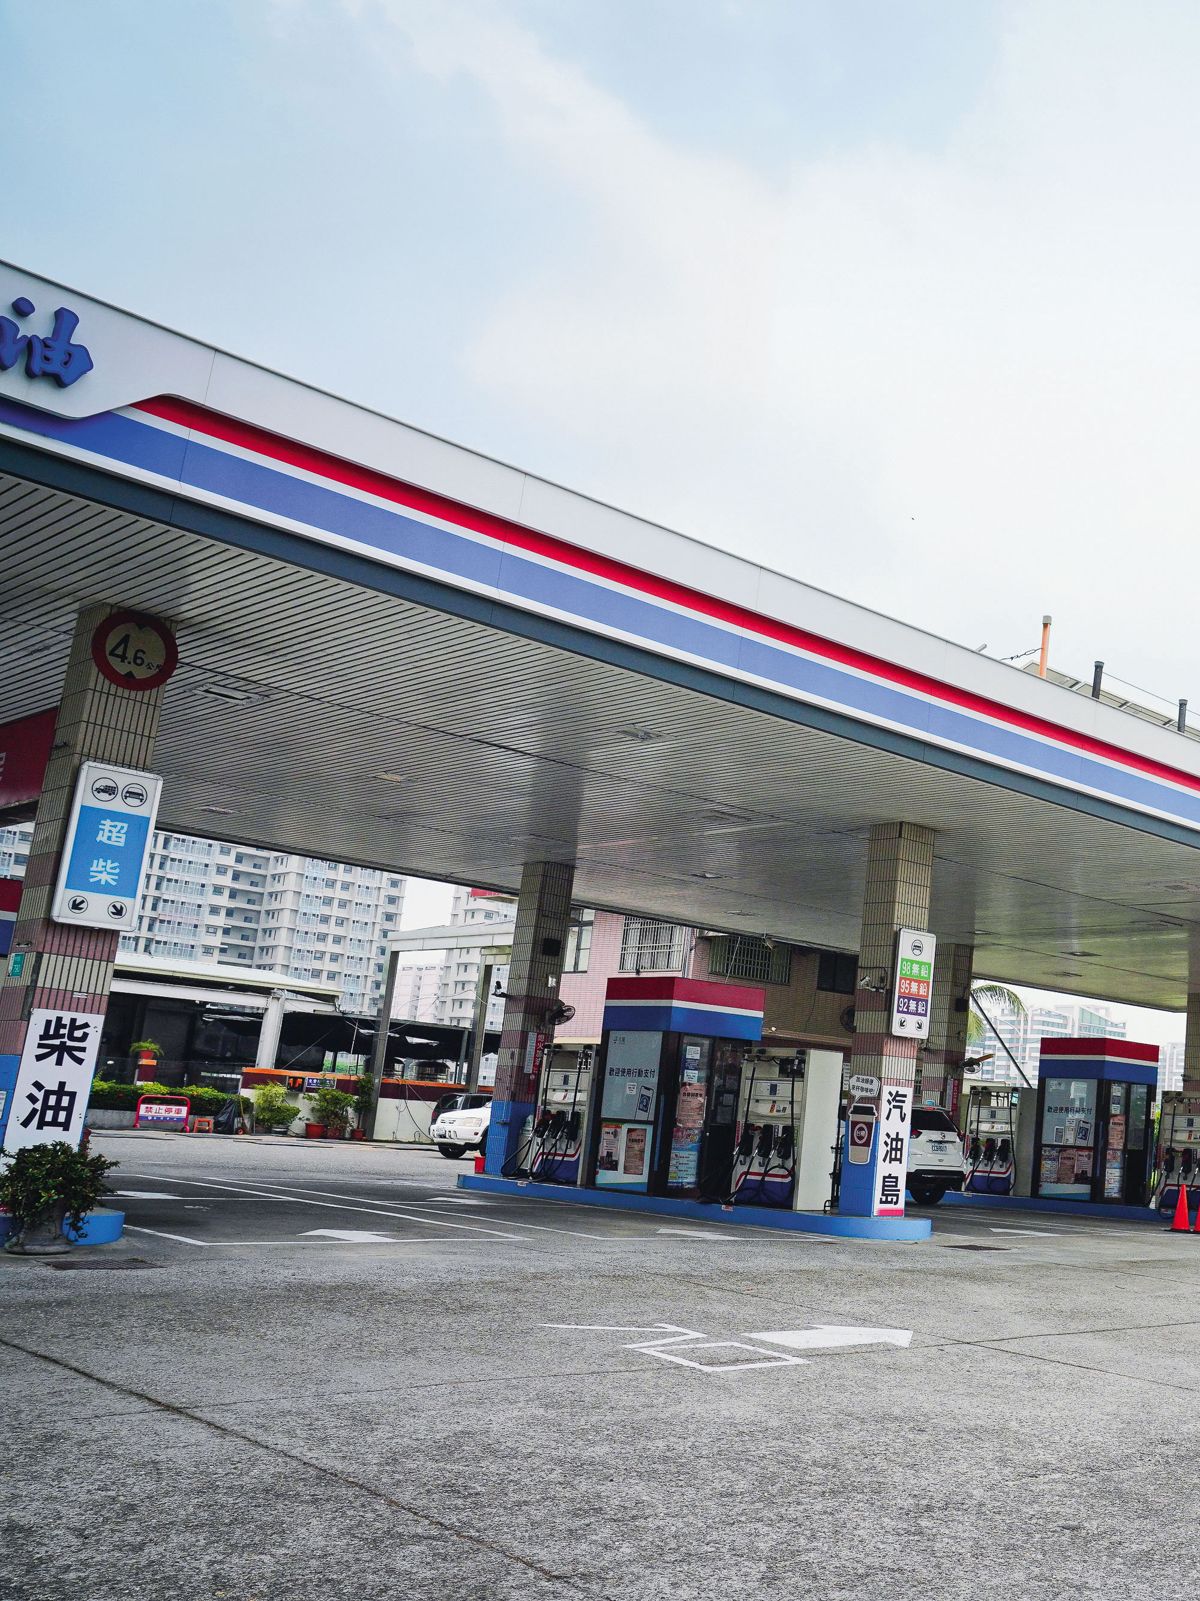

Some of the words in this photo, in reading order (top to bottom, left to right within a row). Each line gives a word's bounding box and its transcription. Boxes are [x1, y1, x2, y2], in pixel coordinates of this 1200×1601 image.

[108, 633, 146, 666] 4.6
[89, 818, 129, 886] 超柴
[20, 1016, 91, 1132] 柴油
[608, 1067, 655, 1079] 歡迎使用行動支付
[143, 1106, 183, 1115] 禁止停車
[880, 1090, 908, 1205] 汽油島
